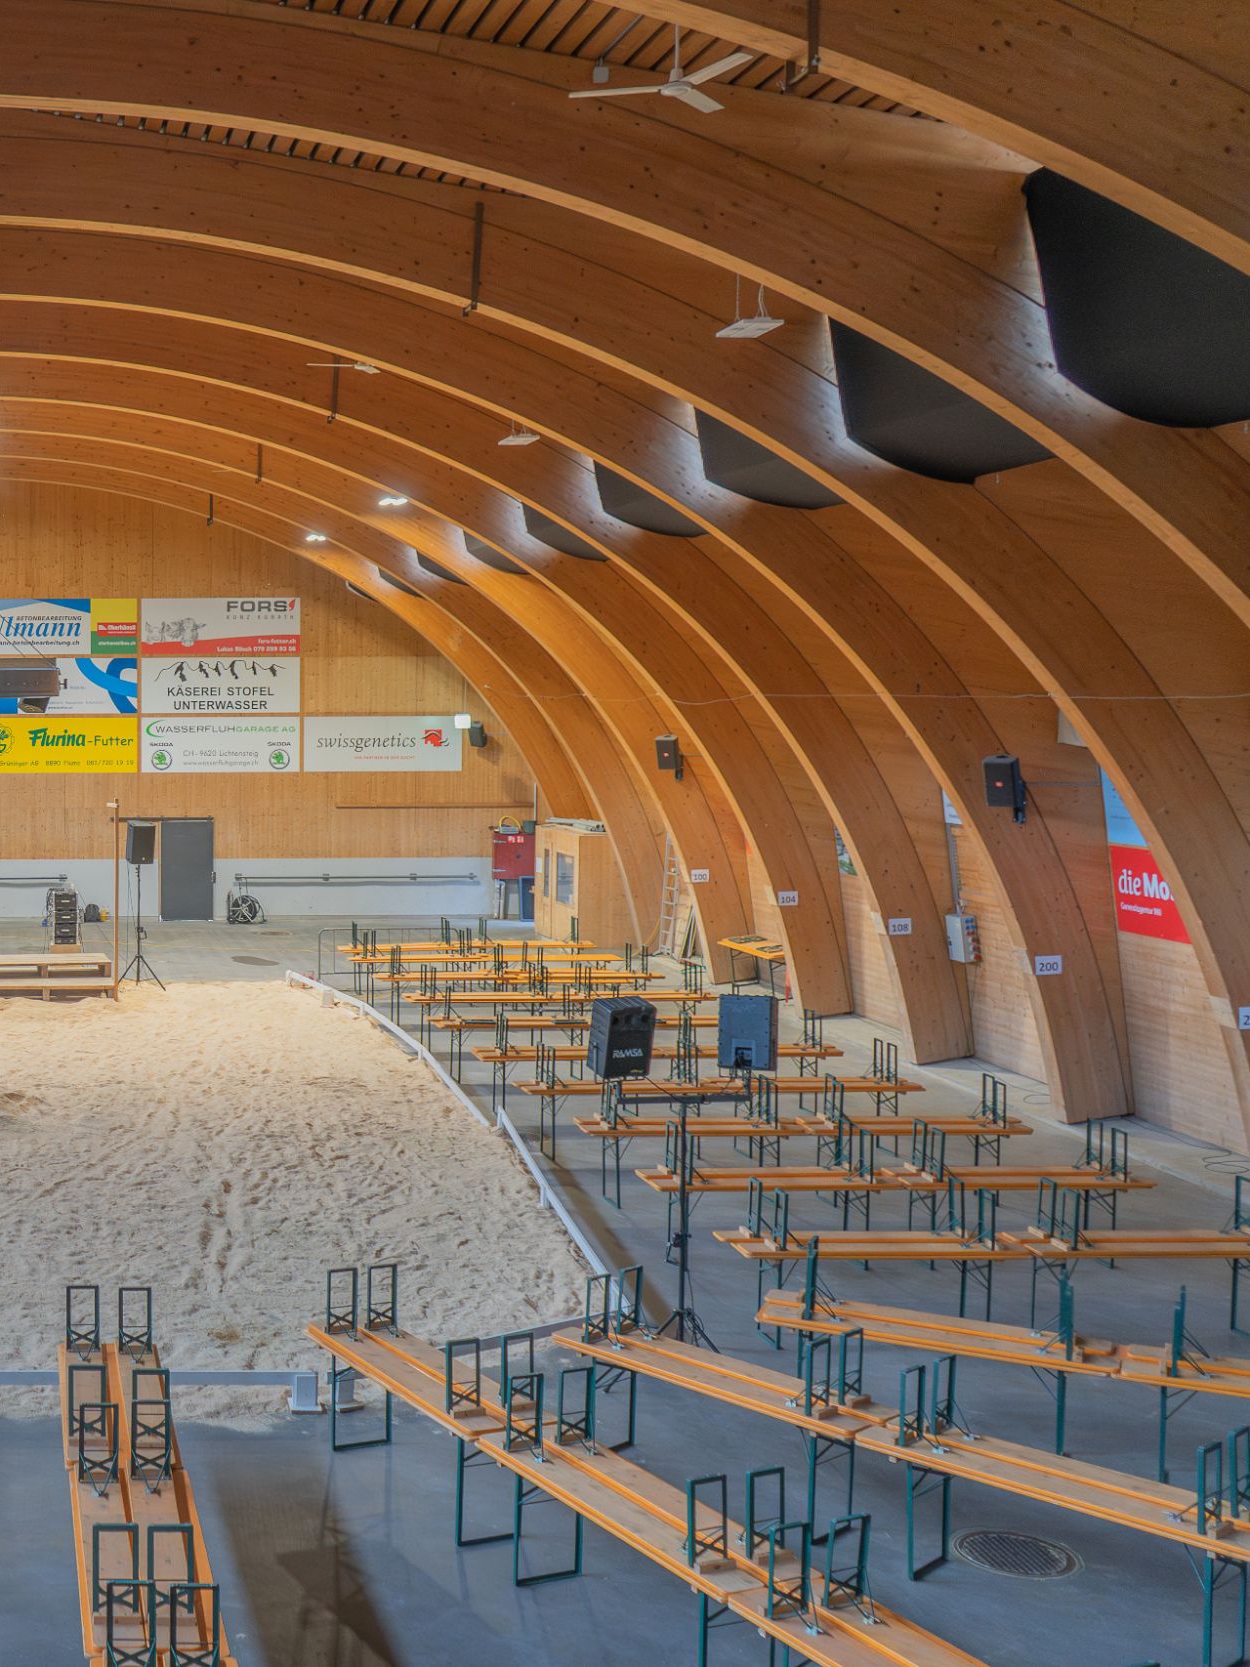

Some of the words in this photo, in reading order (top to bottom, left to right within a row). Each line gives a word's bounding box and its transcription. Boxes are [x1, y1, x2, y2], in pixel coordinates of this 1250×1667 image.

[226, 600, 288, 612] FORS
[167, 685, 221, 697] KÄSEREI
[227, 686, 275, 696] STOFEL
[173, 700, 268, 711] UNTERWASSER
[316, 732, 417, 753] swissgenetics
[693, 873, 708, 881] 100
[1142, 872, 1176, 901] Mo
[781, 895, 796, 904] 104
[891, 923, 909, 933] 108
[1039, 961, 1059, 972] 200
[612, 1048, 644, 1059] RAMSA
